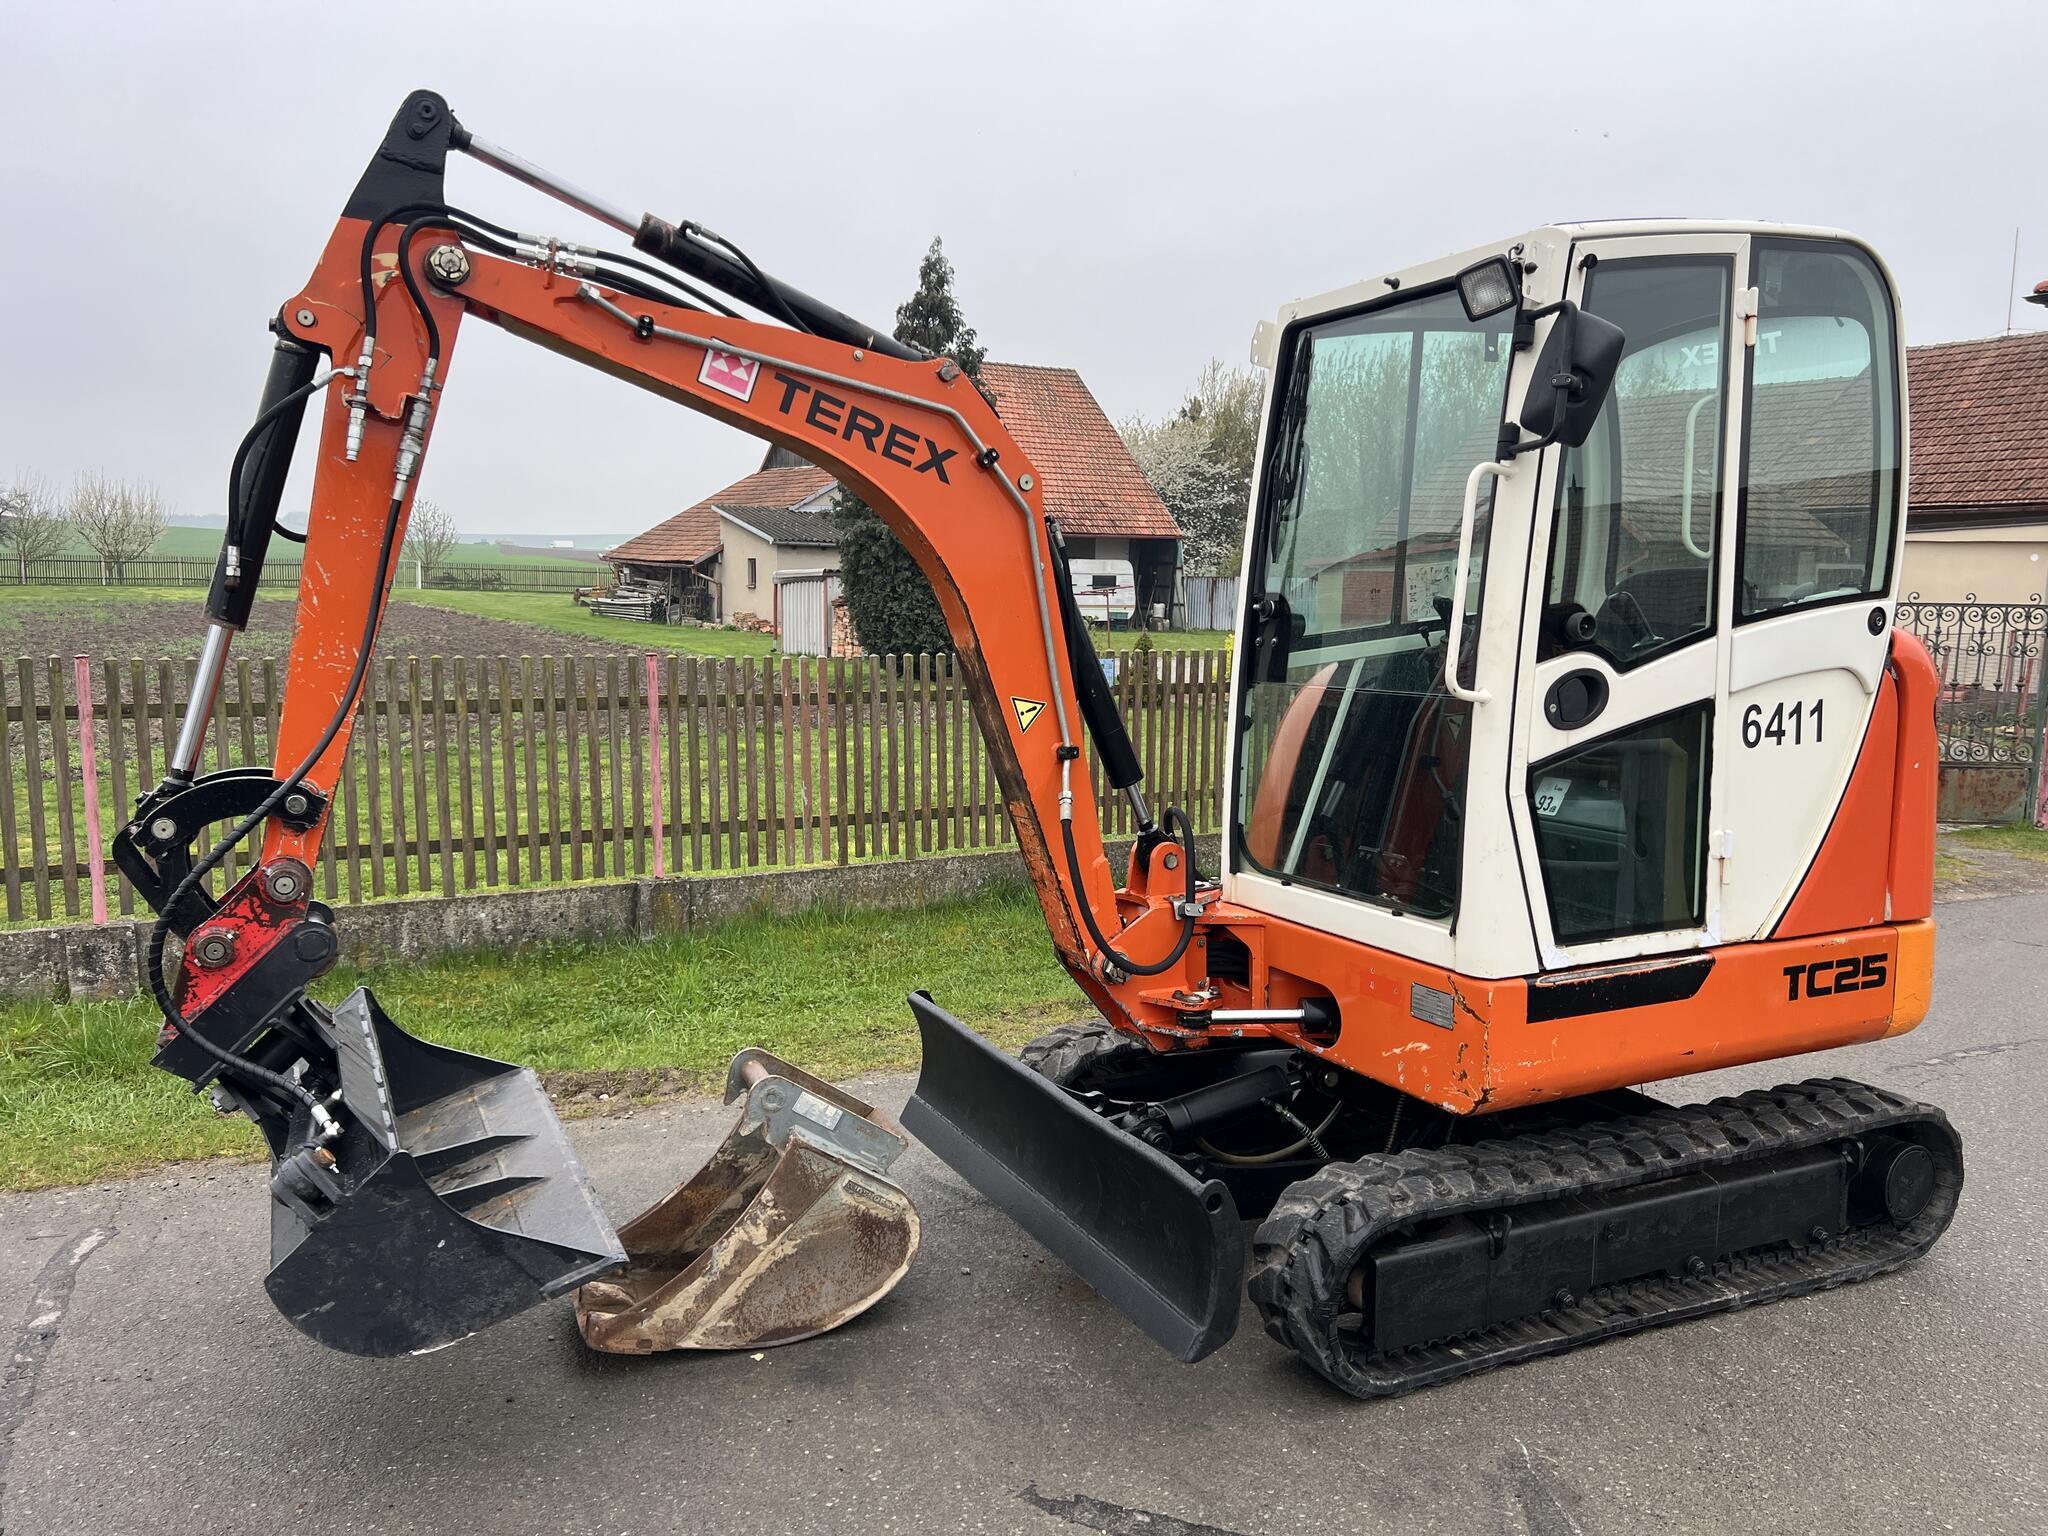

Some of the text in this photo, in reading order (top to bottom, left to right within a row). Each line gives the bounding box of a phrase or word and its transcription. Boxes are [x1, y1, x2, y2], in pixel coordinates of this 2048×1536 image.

[774, 372, 959, 486] TEREX
[1742, 698, 1823, 749] 6411
[1536, 795, 1554, 811] 93
[1783, 953, 1888, 1001] TC25
